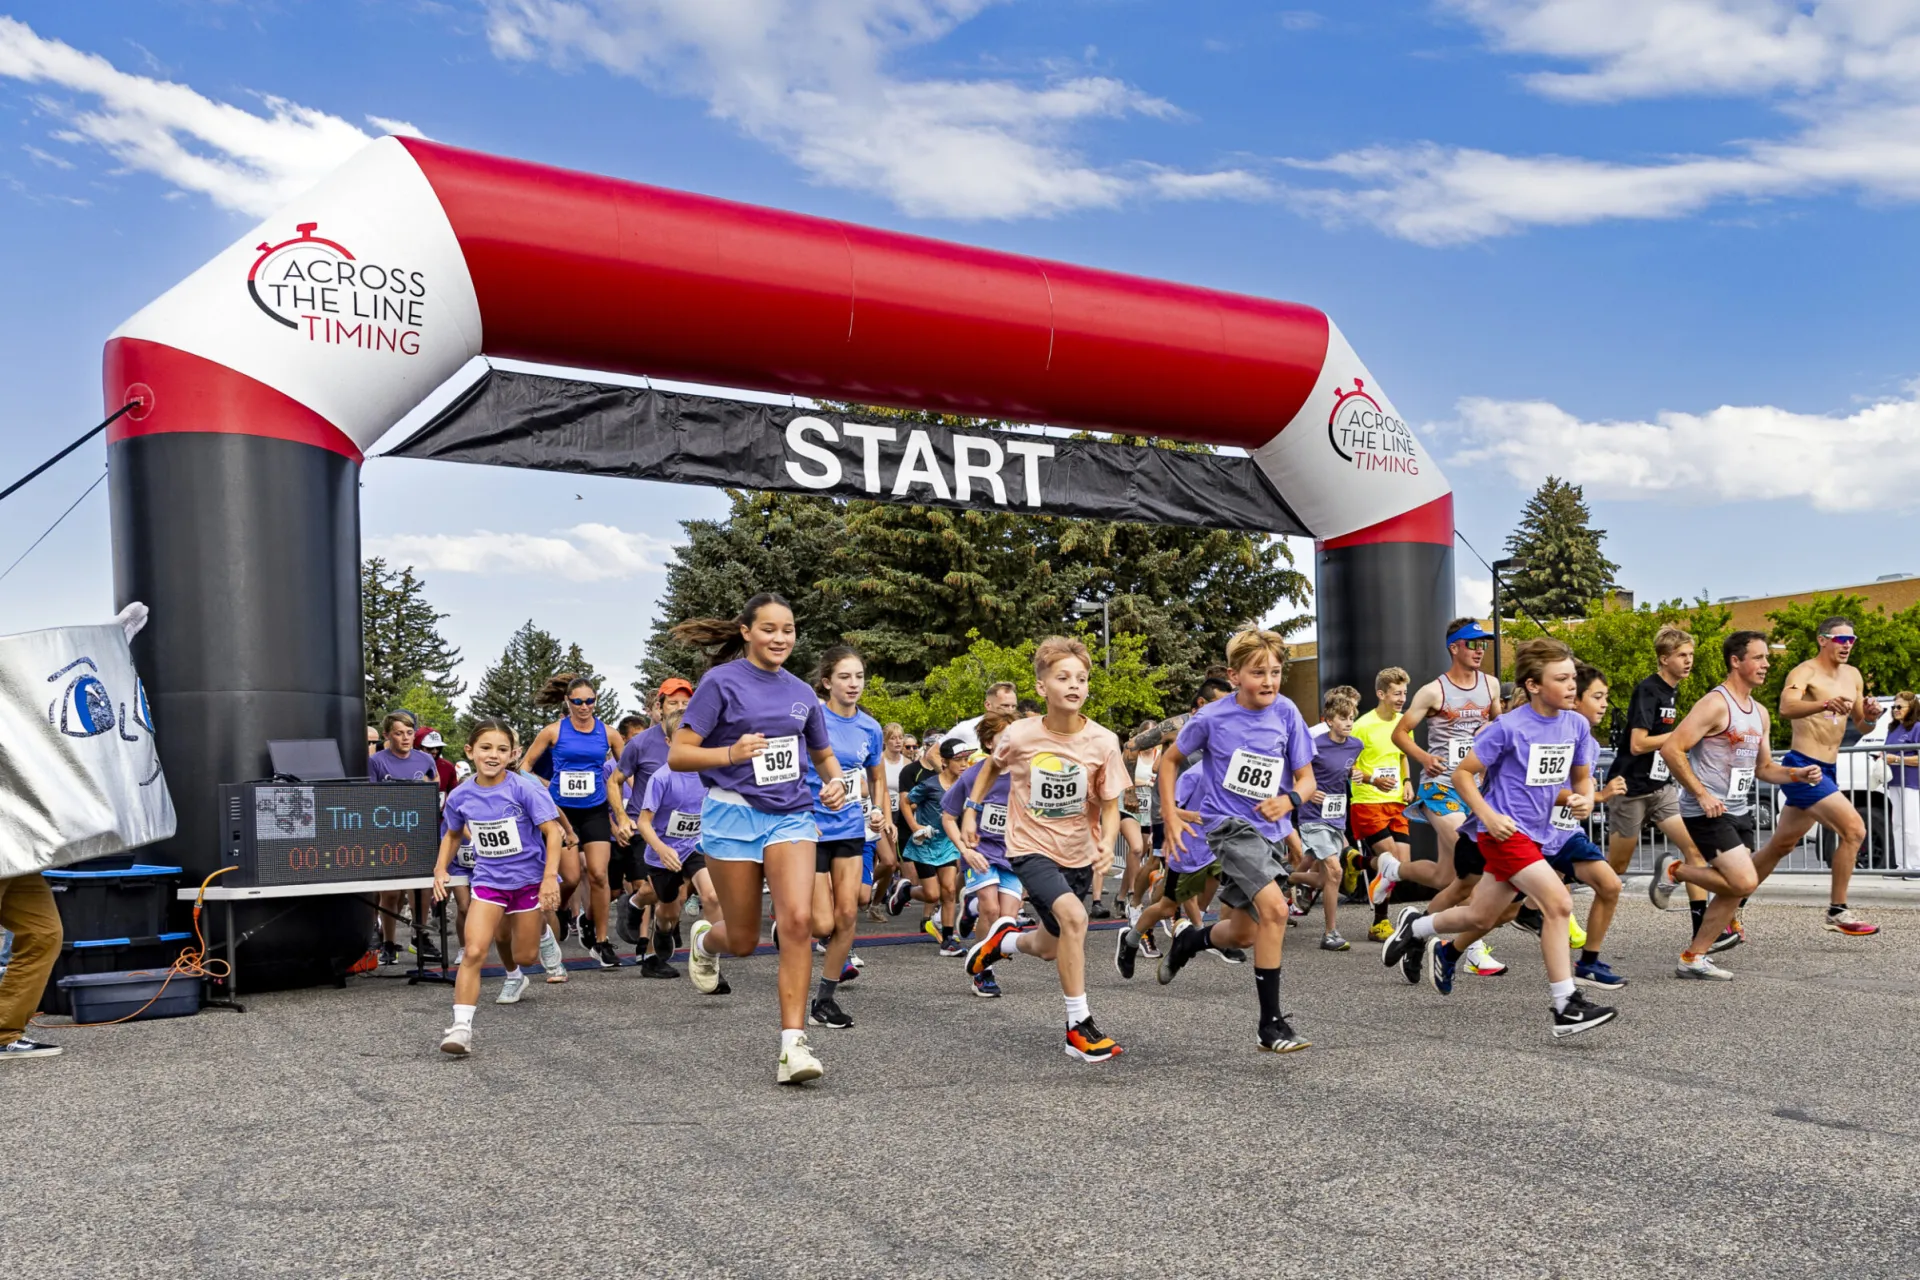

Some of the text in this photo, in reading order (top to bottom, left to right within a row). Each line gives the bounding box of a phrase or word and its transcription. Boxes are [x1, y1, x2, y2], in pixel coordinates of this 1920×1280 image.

[283, 259, 426, 298] ACROSS
[268, 284, 425, 327] THE LINE
[301, 314, 420, 356] TIMING
[1348, 409, 1411, 439] ACROSS
[1339, 428, 1416, 457] THE LINE
[784, 415, 1056, 508] START
[1354, 451, 1419, 476] TIMING
[764, 749, 793, 772] 592
[1538, 756, 1566, 775] 552
[568, 779, 587, 791] 641
[1237, 765, 1273, 788] 683
[1041, 781, 1077, 799] 639
[1236, 786, 1248, 794] CUP
[1327, 801, 1342, 813] 616
[325, 806, 362, 830] Tin
[372, 805, 420, 833] Cup
[676, 820, 702, 832] 642
[989, 812, 1007, 827] 65
[478, 830, 510, 848] 698
[288, 842, 409, 871] 00:00:00
[463, 852, 476, 862] 64
